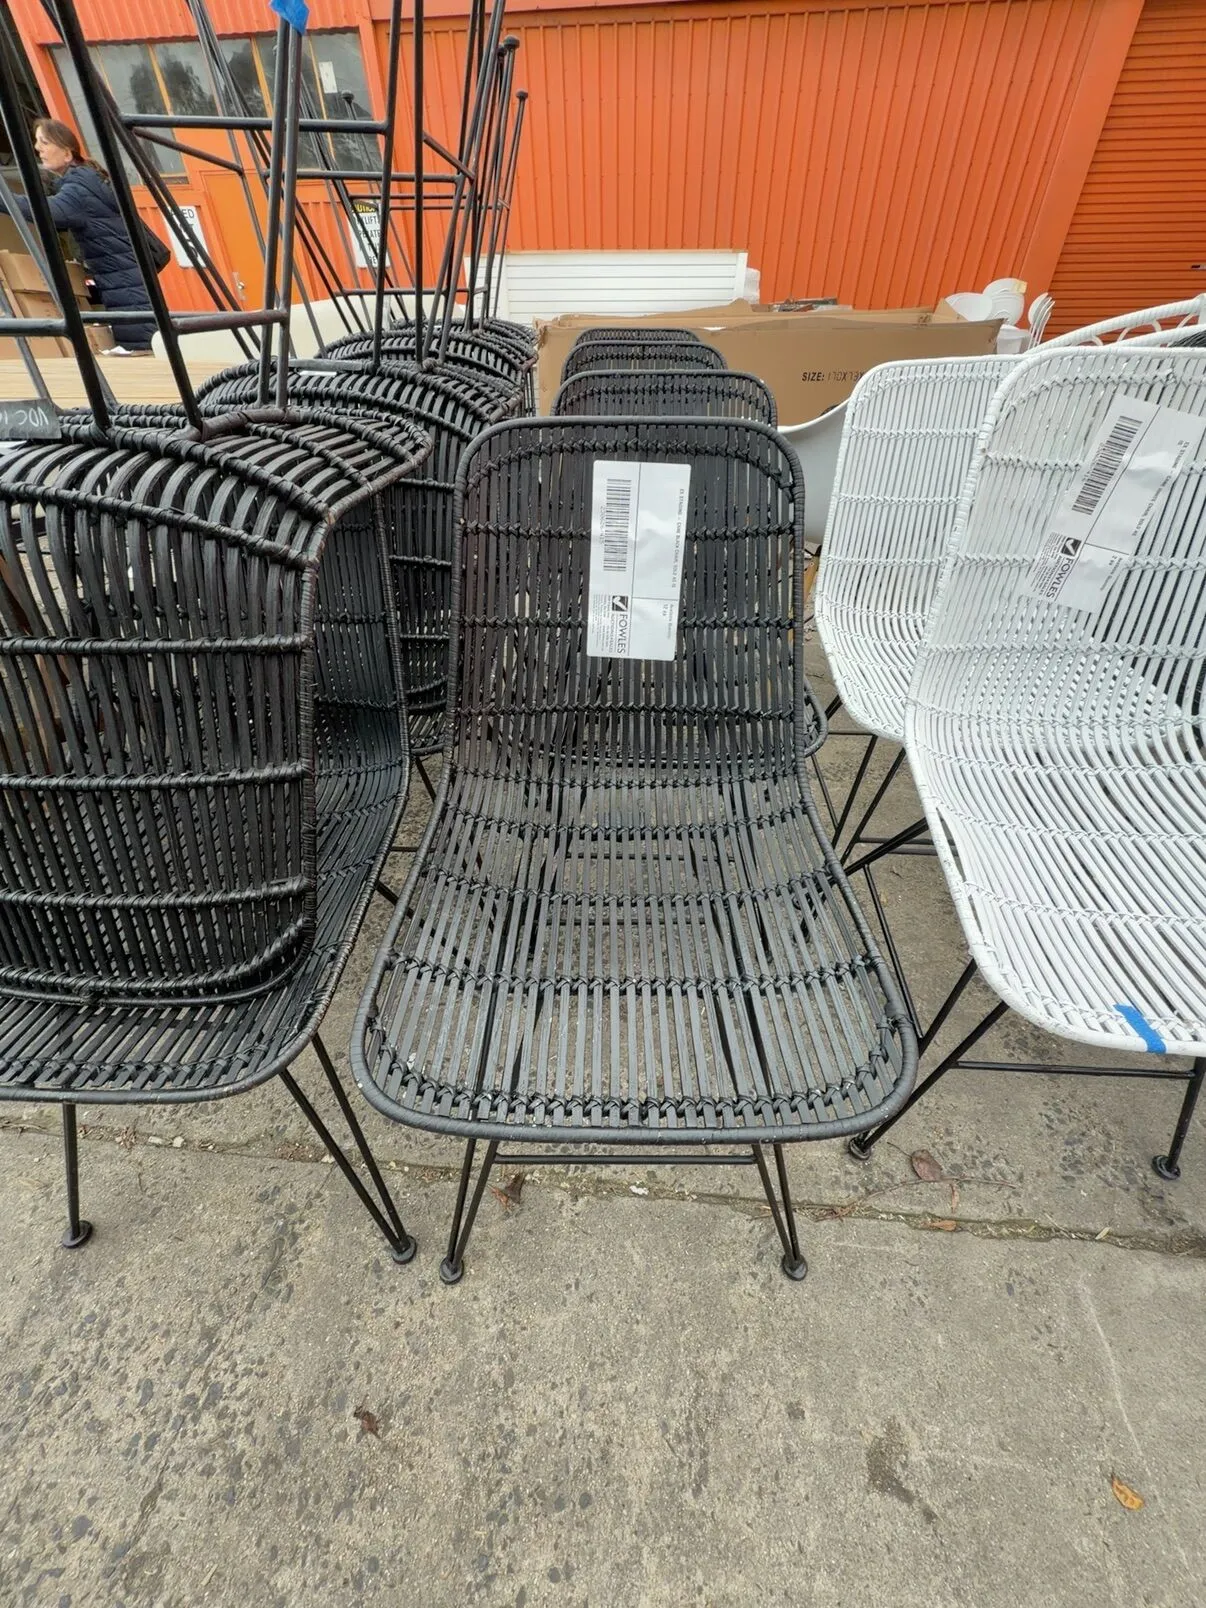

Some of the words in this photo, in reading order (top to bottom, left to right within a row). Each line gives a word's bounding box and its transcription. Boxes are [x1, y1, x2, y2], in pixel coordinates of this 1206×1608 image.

[801, 371, 825, 382] SIZE:
[1046, 557, 1073, 599] FOWLES
[617, 613, 628, 654] FOWLES
